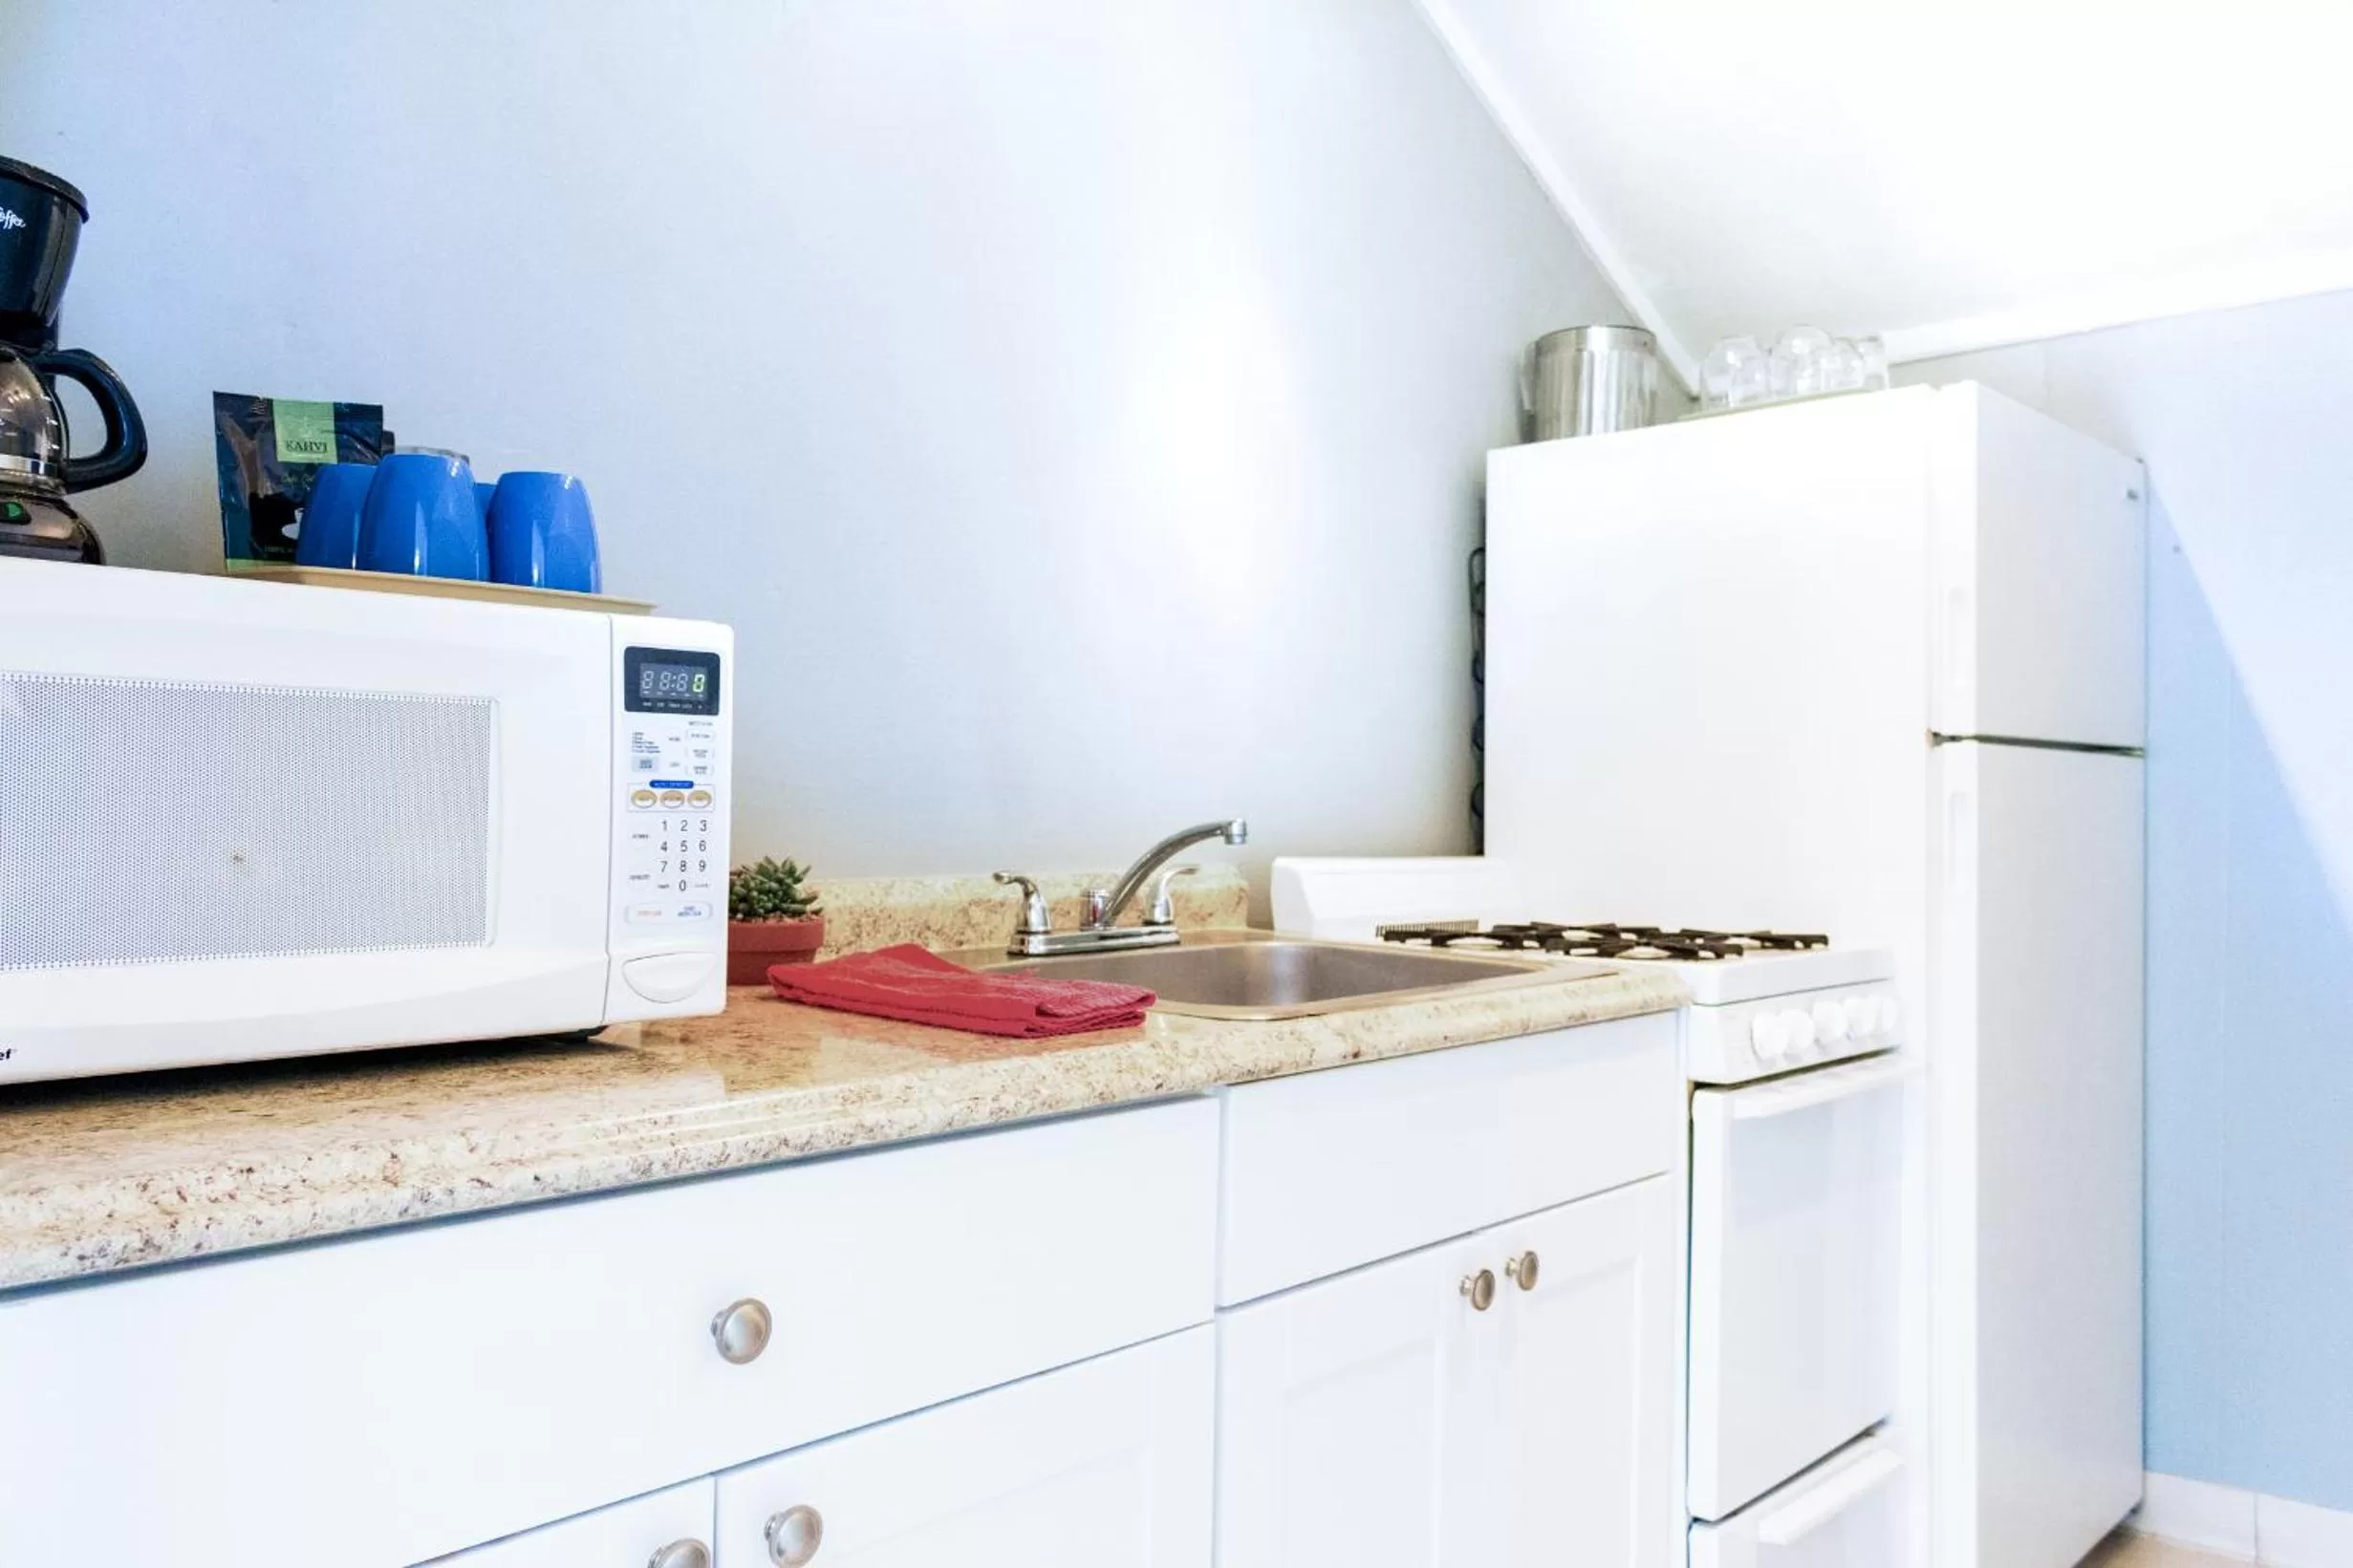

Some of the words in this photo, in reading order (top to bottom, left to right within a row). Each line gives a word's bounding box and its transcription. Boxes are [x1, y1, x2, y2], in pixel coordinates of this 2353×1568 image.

[285, 440, 328, 454] KAHVI
[661, 819, 668, 831] 1
[680, 819, 688, 832] 2
[700, 819, 707, 832] 3
[659, 840, 668, 852] 4
[680, 840, 688, 852] 5
[699, 840, 707, 852] 6
[659, 861, 668, 872] 7
[679, 860, 687, 872] 8
[699, 860, 706, 872] 9
[679, 879, 686, 891] 0
